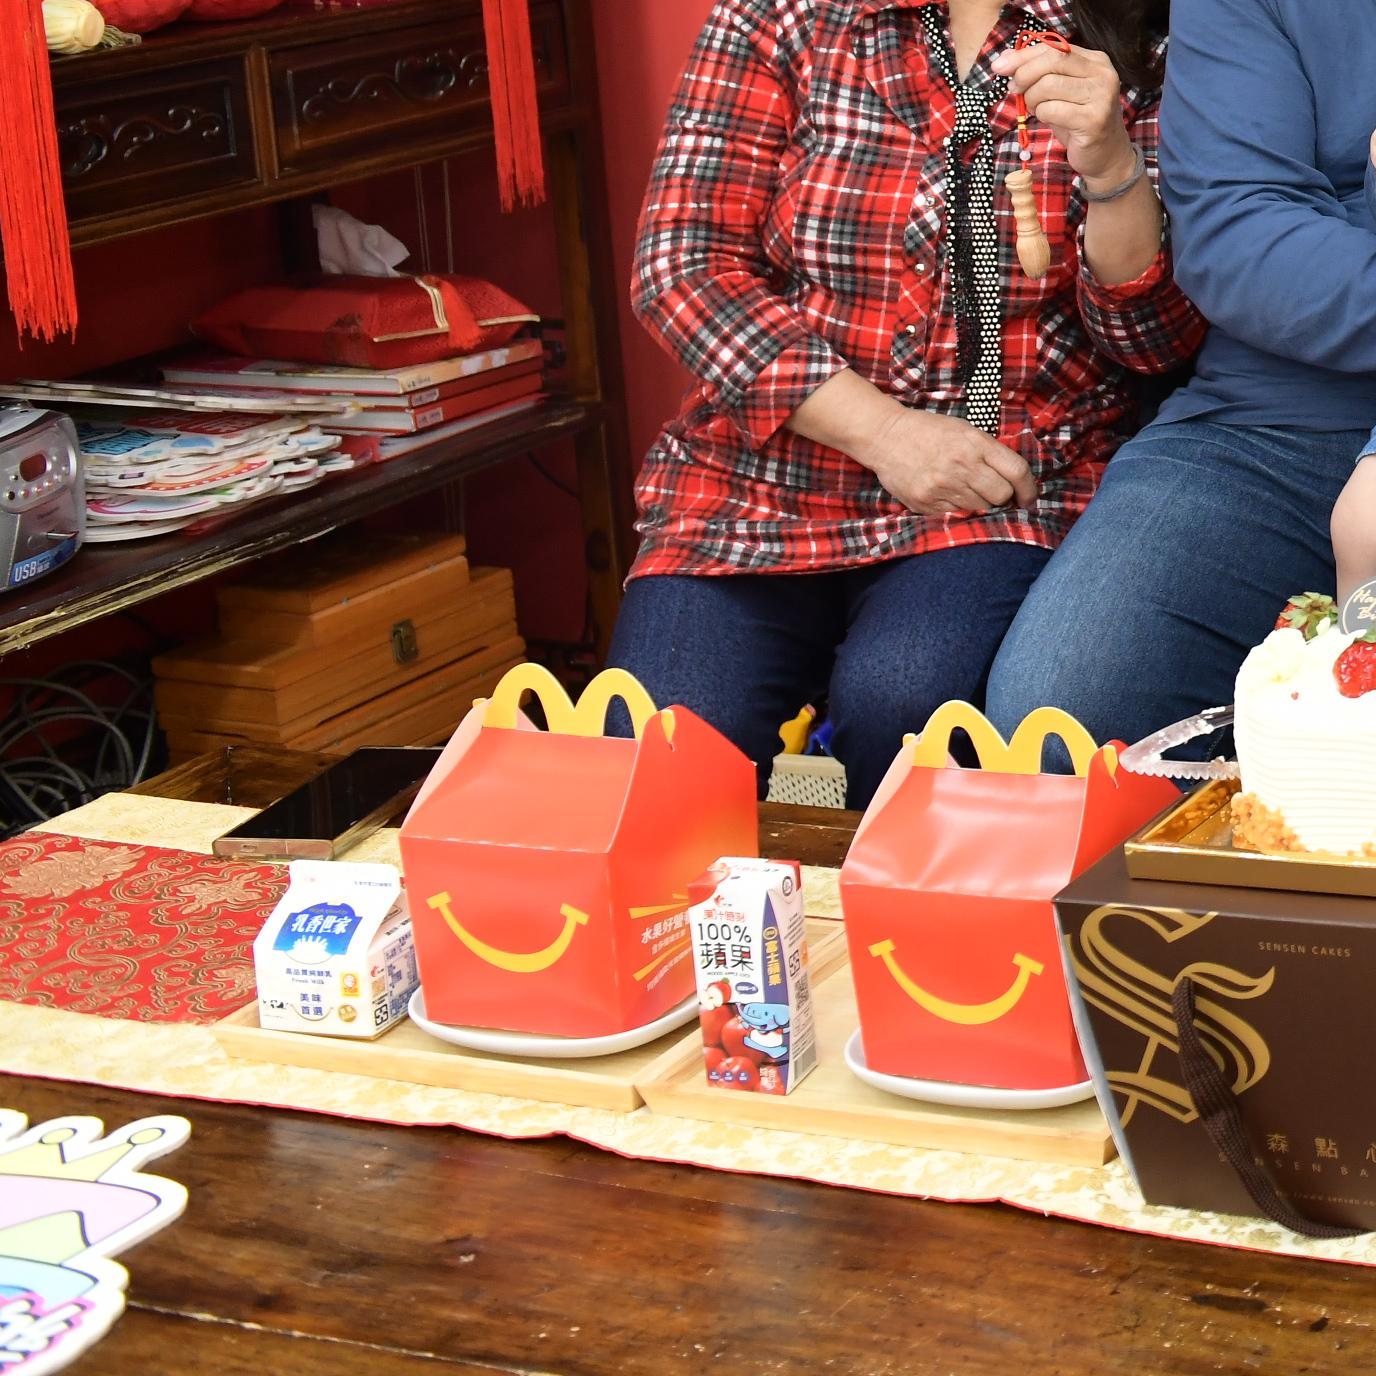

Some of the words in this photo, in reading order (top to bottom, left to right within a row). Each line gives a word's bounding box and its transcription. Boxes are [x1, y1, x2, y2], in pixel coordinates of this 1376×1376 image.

[14, 561, 37, 582] USB
[291, 913, 352, 935] 乳香世家
[698, 923, 752, 943] 100%
[700, 942, 754, 971] 蘋果
[1258, 941, 1306, 954] SENSEN
[1311, 945, 1351, 957] CAKES
[300, 993, 321, 1003] 美味
[301, 1006, 323, 1016] 首選
[1218, 1152, 1321, 1173] SNSEN
